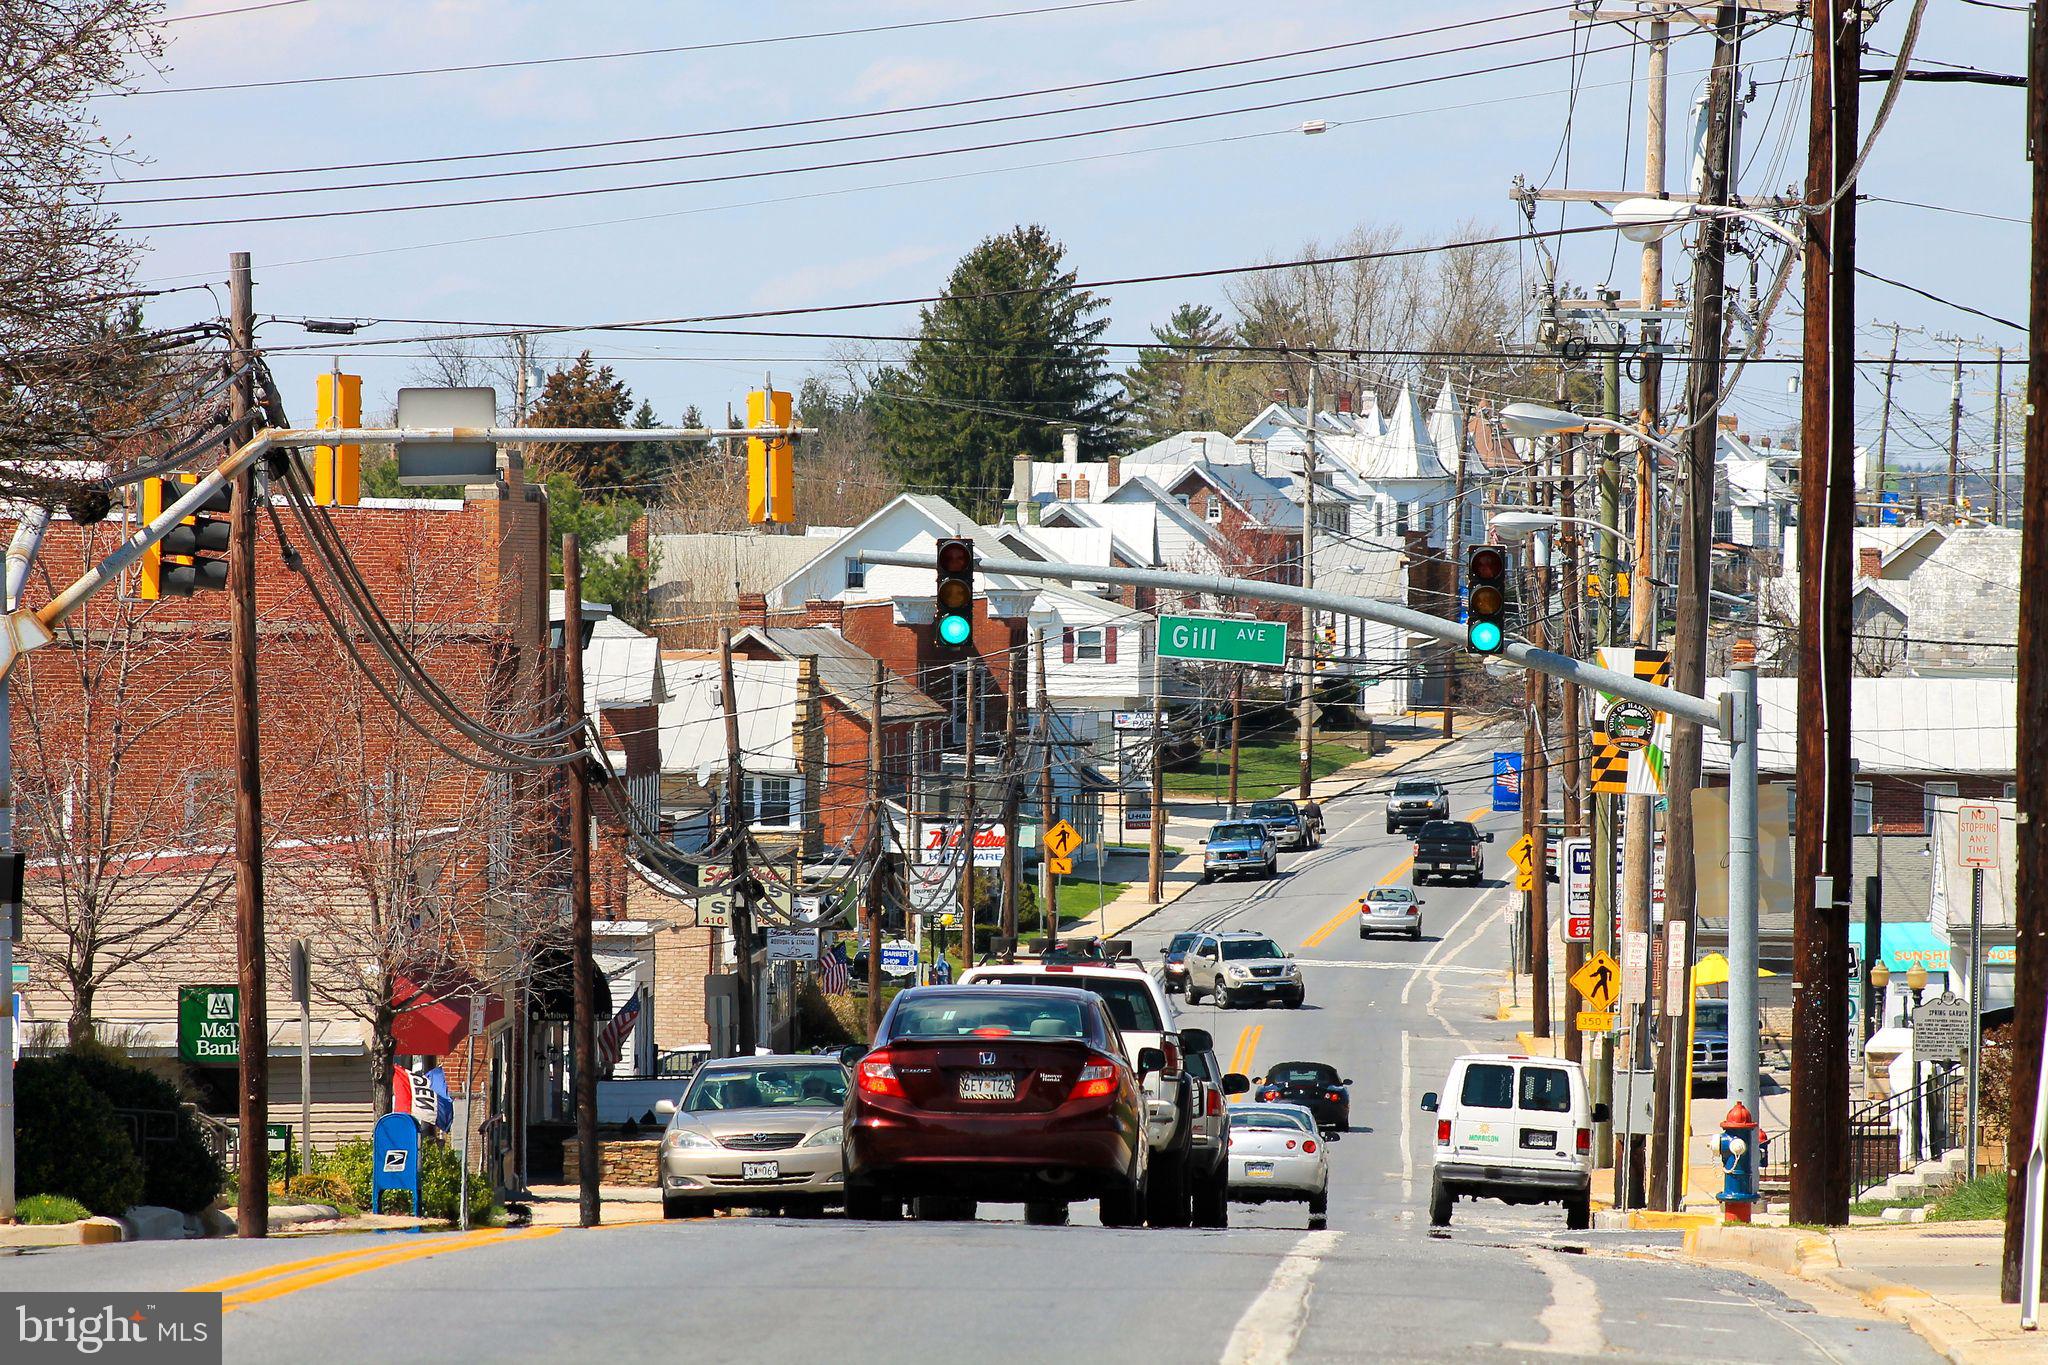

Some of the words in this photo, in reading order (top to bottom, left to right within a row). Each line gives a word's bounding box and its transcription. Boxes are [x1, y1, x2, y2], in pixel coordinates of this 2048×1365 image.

[1172, 625, 1216, 650] Gill
[1236, 628, 1266, 642] AVE
[1608, 711, 1618, 732] TOWN
[1616, 703, 1626, 714] OF
[1128, 813, 1152, 821] U-HAU
[1971, 810, 1986, 821] NO
[1960, 822, 1997, 833] STOPPING
[1968, 835, 1988, 843] ANY
[1968, 845, 1989, 855] TIME
[883, 950, 908, 958] BARBER
[1894, 949, 1948, 961] SUNSHI
[883, 958, 900, 966] SHOP
[1581, 1017, 1602, 1026] 350
[200, 1022, 240, 1038] M&T
[196, 1040, 240, 1056] Bank
[1468, 1134, 1499, 1143] MORRISON
